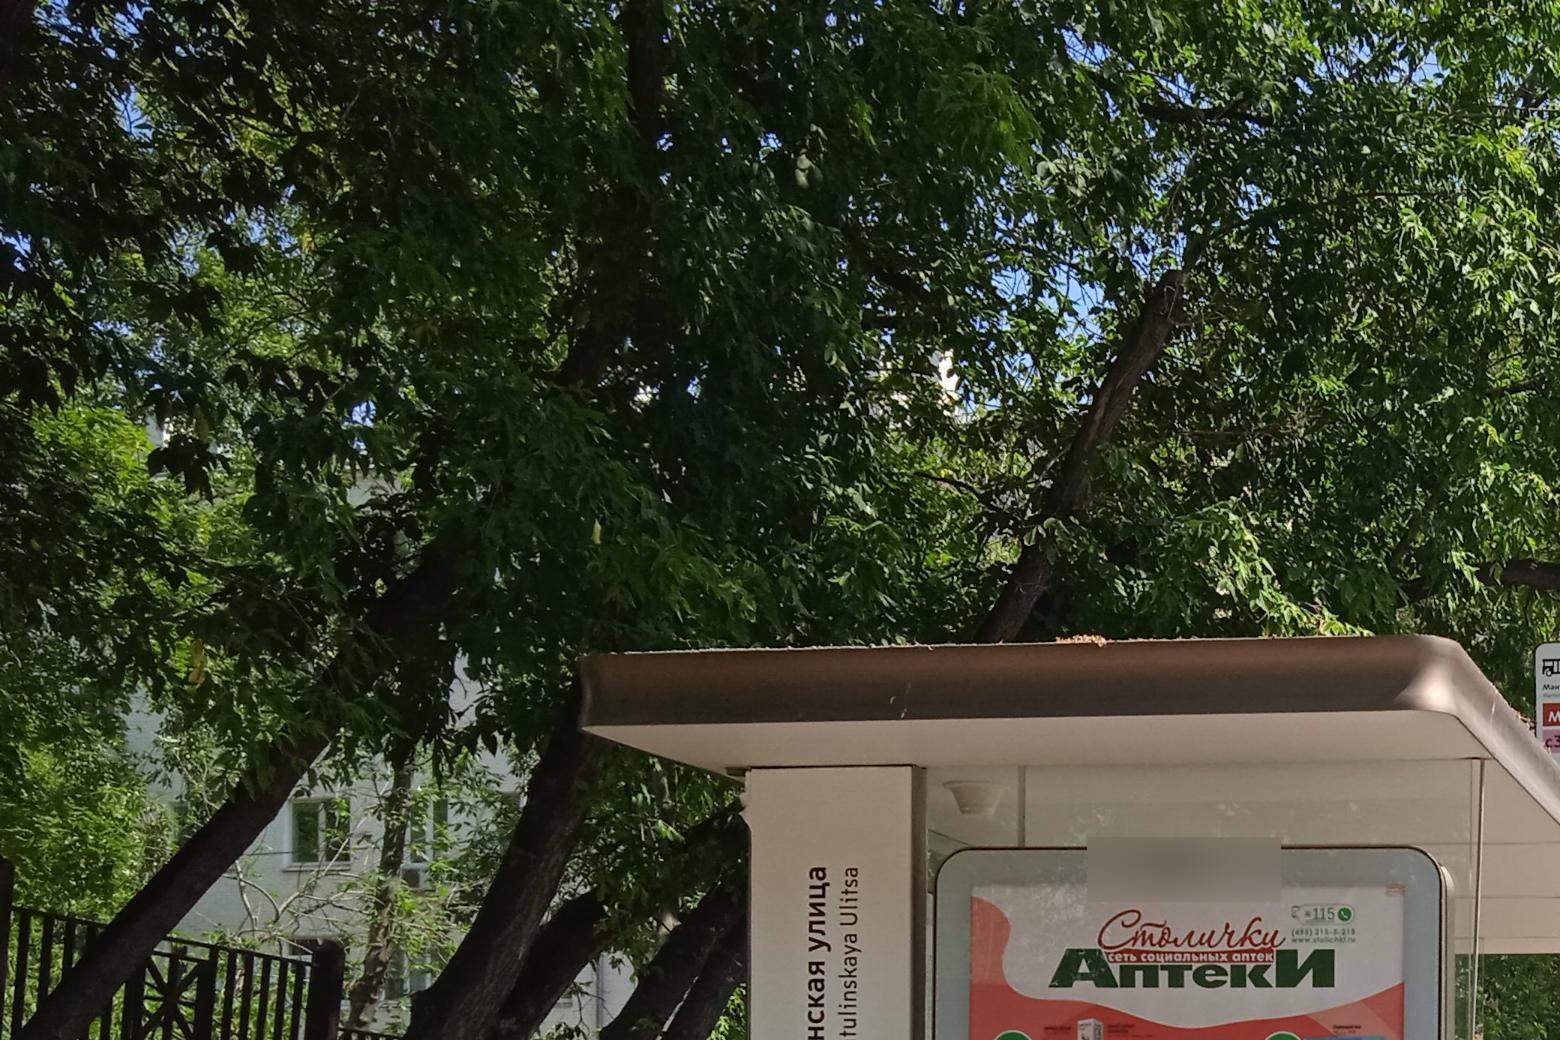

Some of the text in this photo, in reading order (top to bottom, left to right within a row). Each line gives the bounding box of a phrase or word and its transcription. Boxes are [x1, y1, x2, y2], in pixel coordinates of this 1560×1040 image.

[808, 866, 832, 952] улица
[839, 867, 859, 925] Ulitsa
[1097, 908, 1286, 950] Столички
[1108, 950, 1274, 962] сеть социальных аптек
